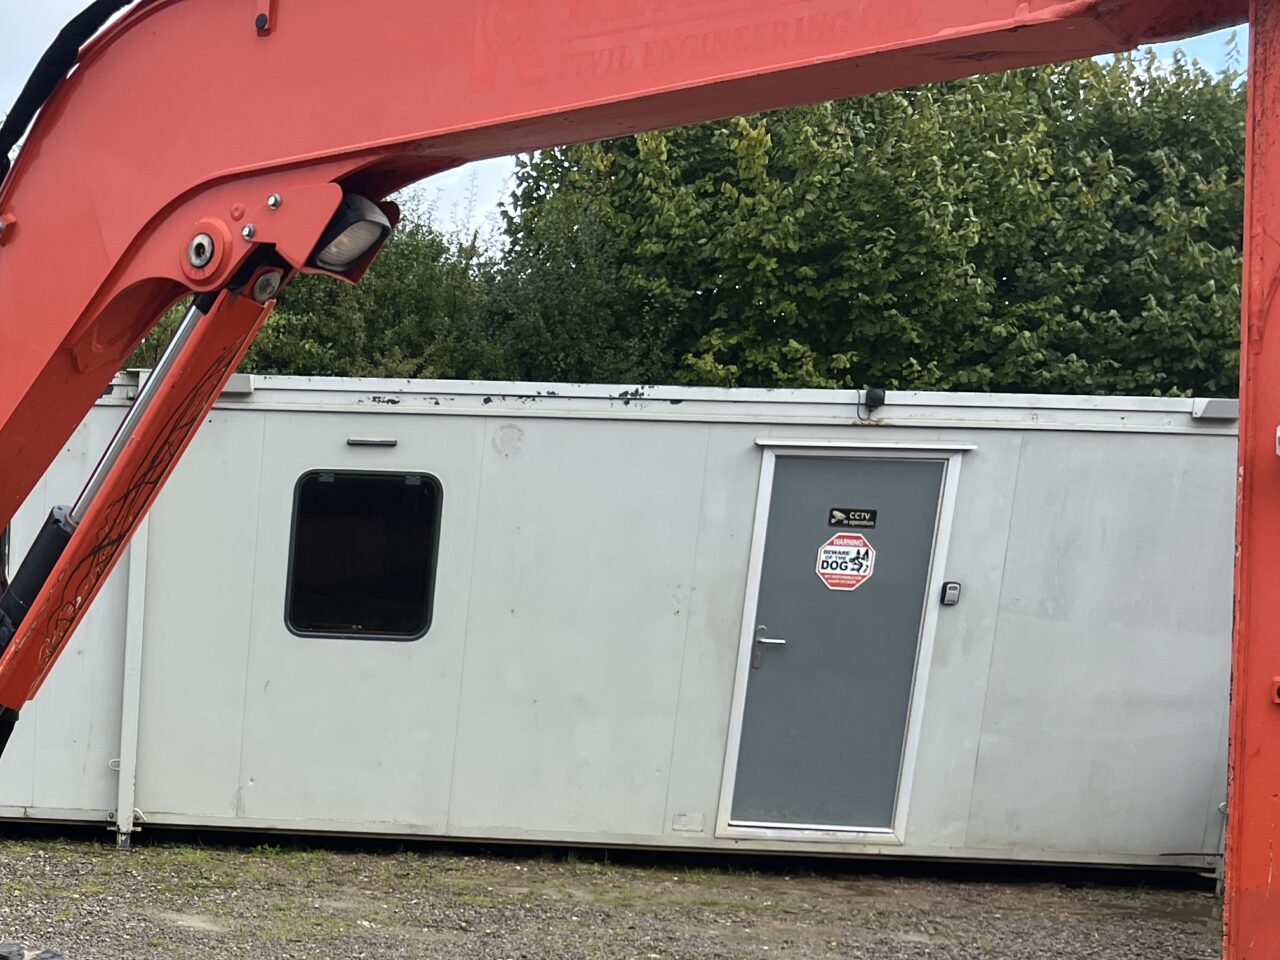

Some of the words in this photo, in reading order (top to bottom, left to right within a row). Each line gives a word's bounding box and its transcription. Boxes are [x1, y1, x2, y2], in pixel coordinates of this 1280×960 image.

[849, 512, 871, 520] CCTV
[833, 539, 864, 547] WARNING
[821, 560, 848, 571] DOG
